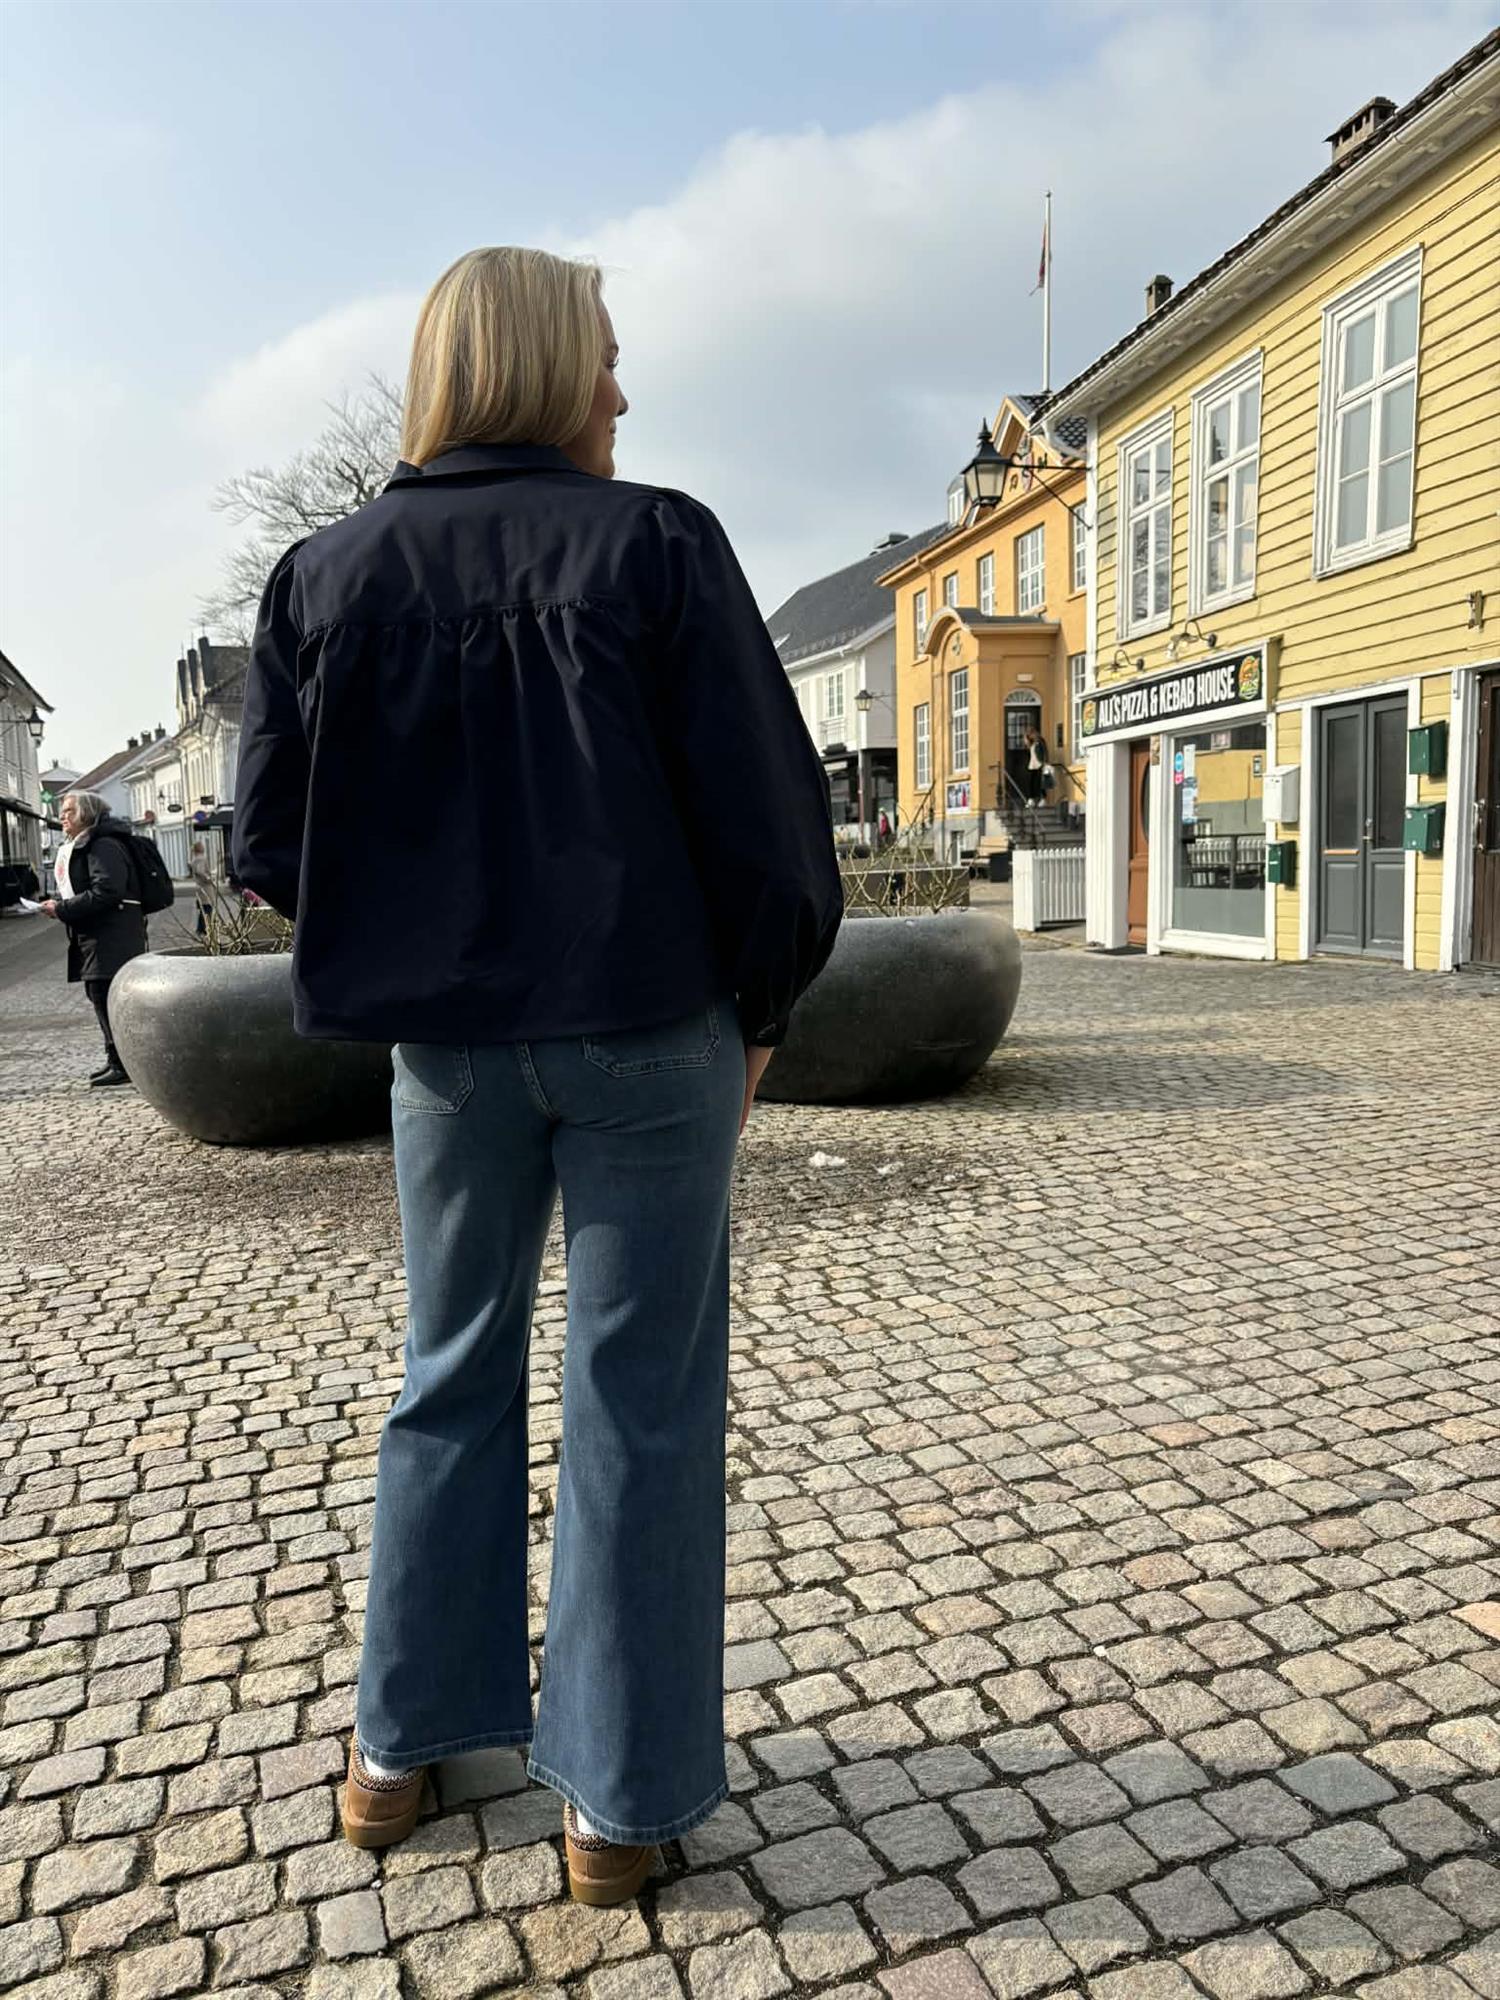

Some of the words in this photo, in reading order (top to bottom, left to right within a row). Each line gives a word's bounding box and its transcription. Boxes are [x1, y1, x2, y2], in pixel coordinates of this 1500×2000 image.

[1099, 694, 1120, 728] ALI'S
[1121, 689, 1149, 722] PIZZA
[1150, 686, 1157, 716] &
[1159, 676, 1195, 714] KEBAB
[1196, 665, 1235, 705] HOUSE
